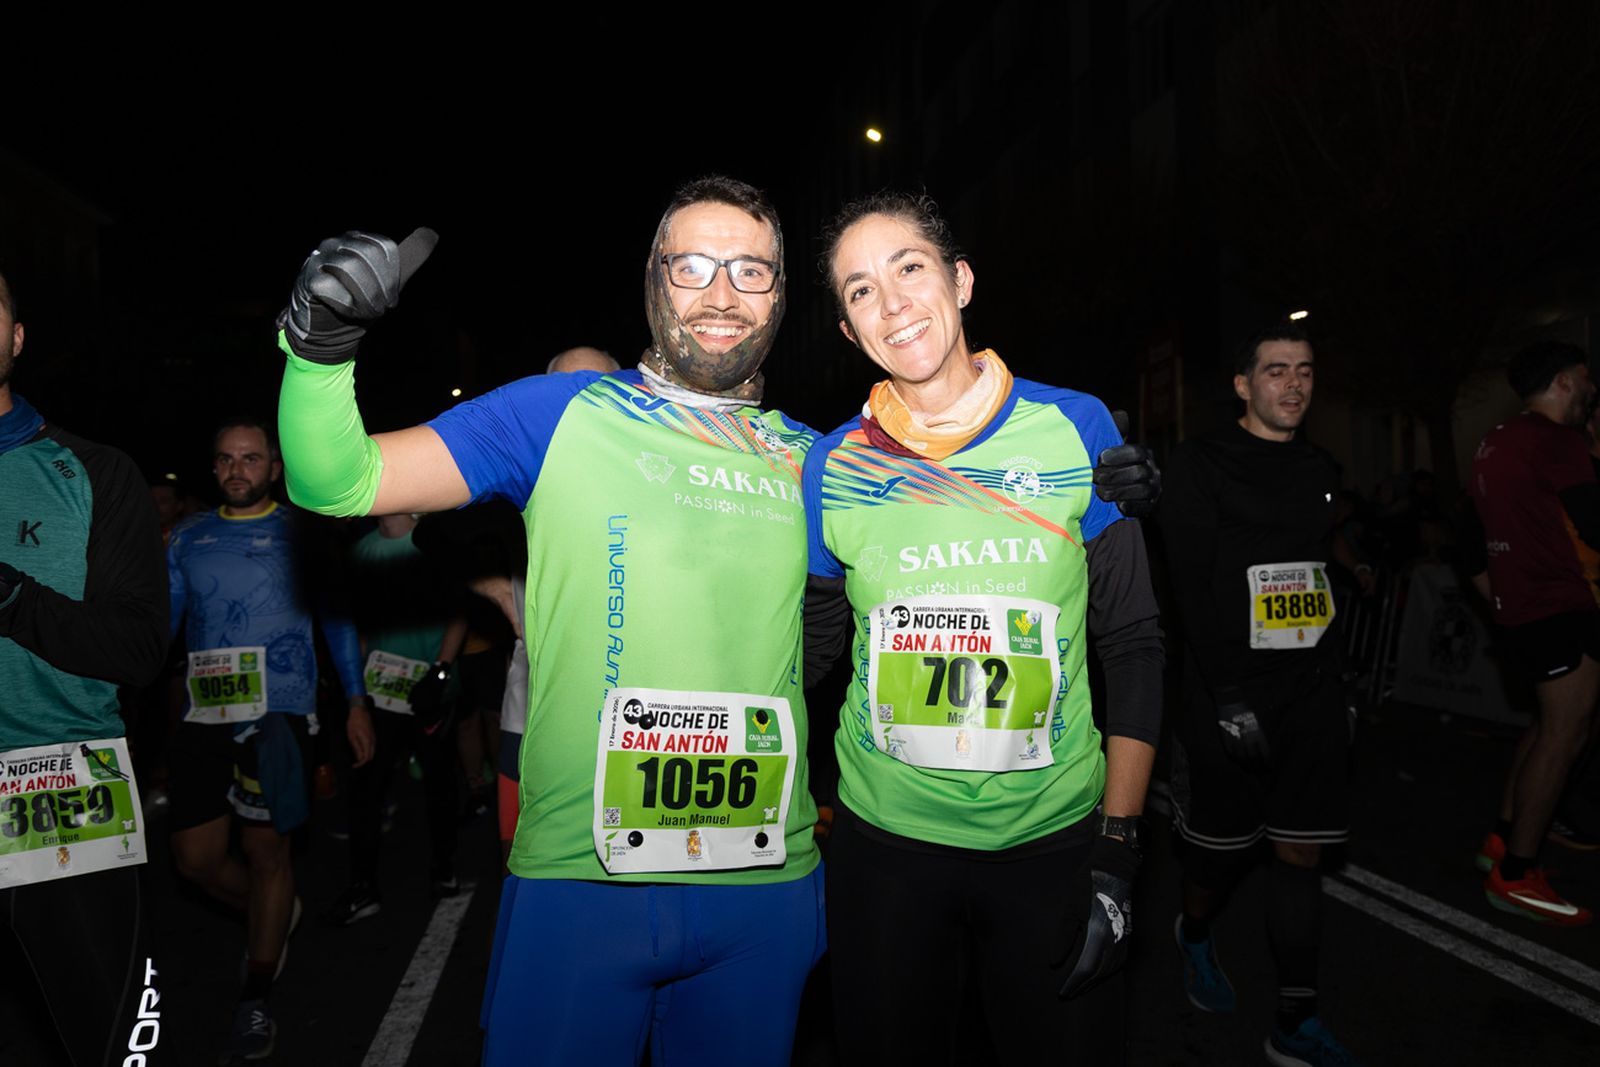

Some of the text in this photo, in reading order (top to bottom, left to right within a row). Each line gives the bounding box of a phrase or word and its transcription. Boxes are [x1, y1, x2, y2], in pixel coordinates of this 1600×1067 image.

[688, 464, 803, 507] SAKATA
[750, 506, 764, 519] in
[766, 507, 796, 526] Seed
[20, 520, 42, 545] K
[898, 537, 1048, 574] SAKATA
[965, 580, 981, 595] in
[985, 577, 1026, 594] Seed
[1261, 583, 1279, 593] SAN
[1261, 592, 1327, 620] 13888
[598, 514, 628, 723] Universo Runn
[913, 613, 991, 630] NOCHE DE
[892, 633, 927, 652] SAN
[199, 673, 249, 699] 9054
[923, 657, 1009, 709] 702
[624, 704, 642, 718] 43
[647, 702, 670, 710] CARRERA
[648, 710, 729, 730] NOCHE DE
[621, 730, 728, 753] SAN ANTÓN
[8, 758, 73, 777] NOCHE DE
[0, 772, 77, 795] AN ANTÓN
[637, 756, 759, 810] 1056
[1, 784, 115, 838] 3859
[657, 813, 731, 827] Juan Manuel
[42, 833, 80, 846] Enrique
